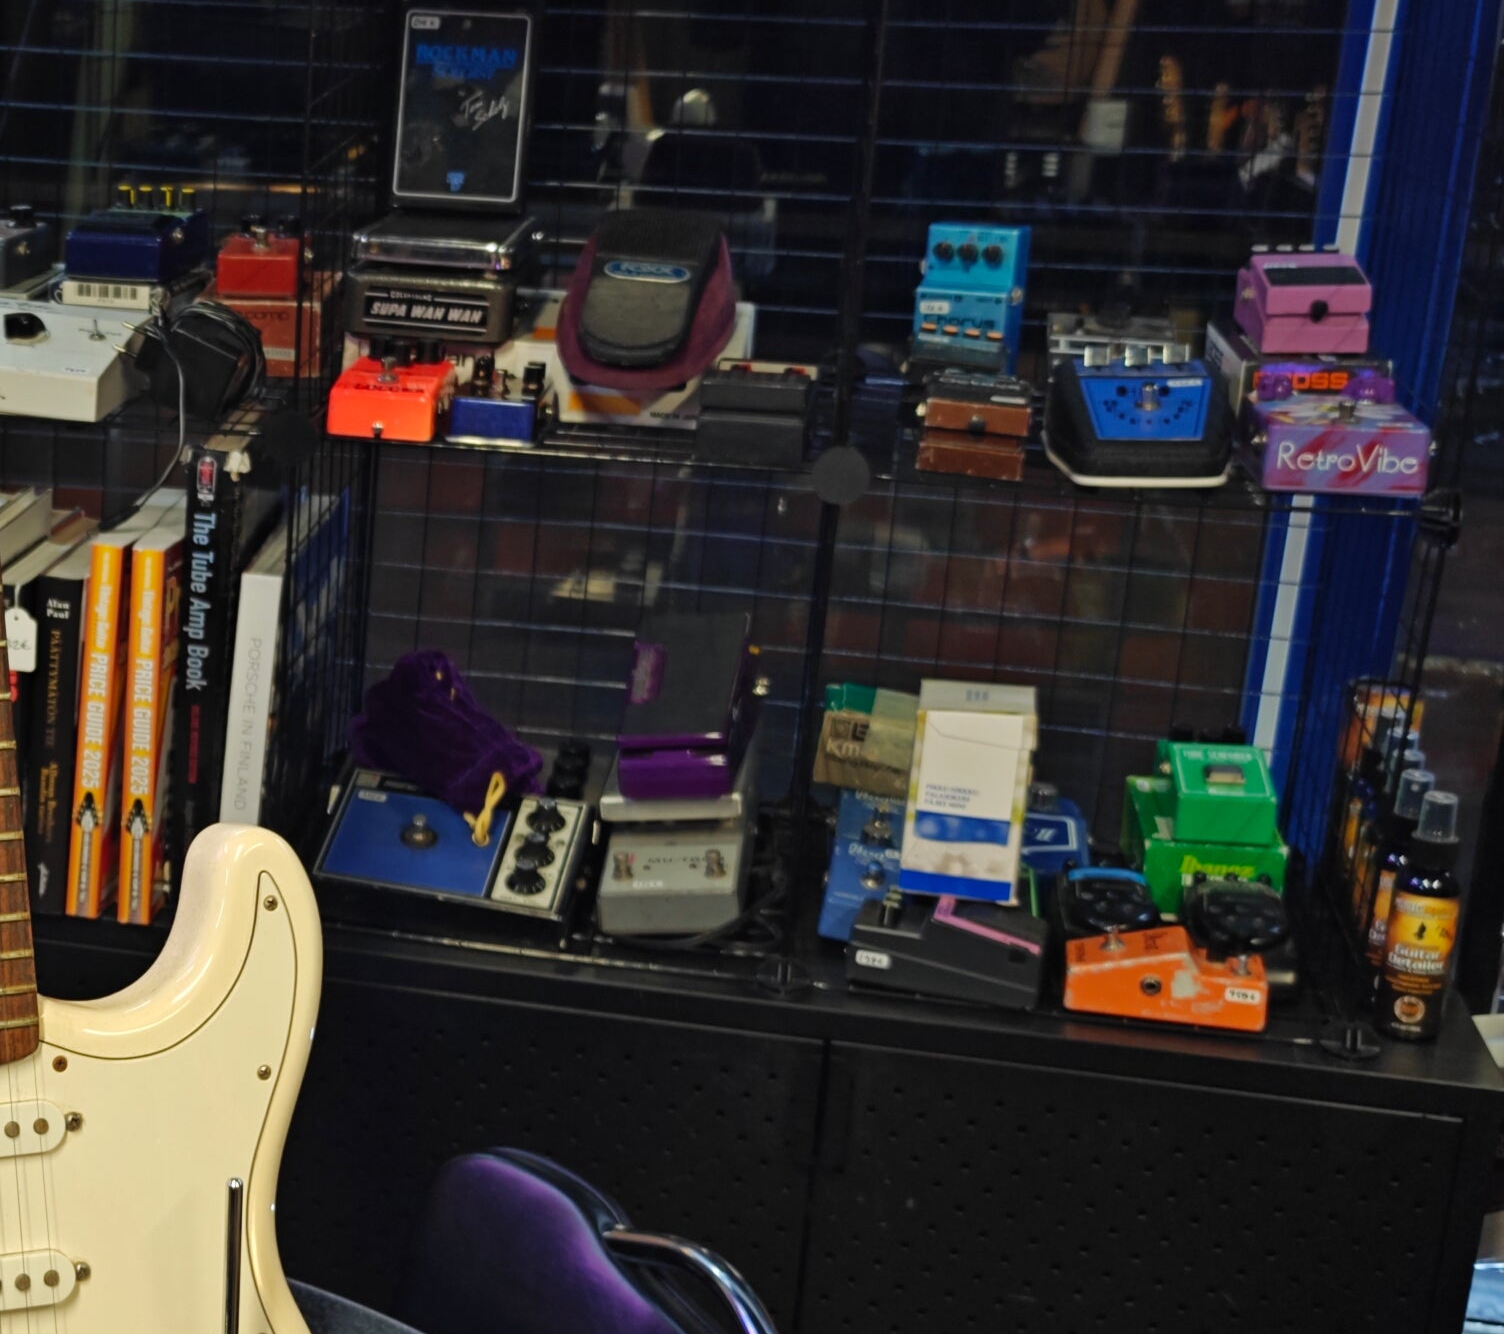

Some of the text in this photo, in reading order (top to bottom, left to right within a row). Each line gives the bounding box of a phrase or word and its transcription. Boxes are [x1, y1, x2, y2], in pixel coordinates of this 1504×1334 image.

[370, 301, 483, 324] SUPA WAH WAH
[1253, 371, 1349, 390] OSS
[192, 511, 217, 546] The
[188, 551, 215, 594] Tube
[46, 598, 70, 610] Alan
[46, 608, 70, 620] Paul
[182, 597, 210, 639] Amp
[88, 653, 108, 697] PRICE
[133, 658, 154, 703] PRICE
[184, 644, 209, 692] Book
[85, 701, 105, 745] GUIDE
[131, 707, 152, 751] GUIDE
[233, 637, 263, 811] PORSCHE IN FINLAND
[81, 748, 102, 790] 2025
[130, 754, 150, 796] 2025
